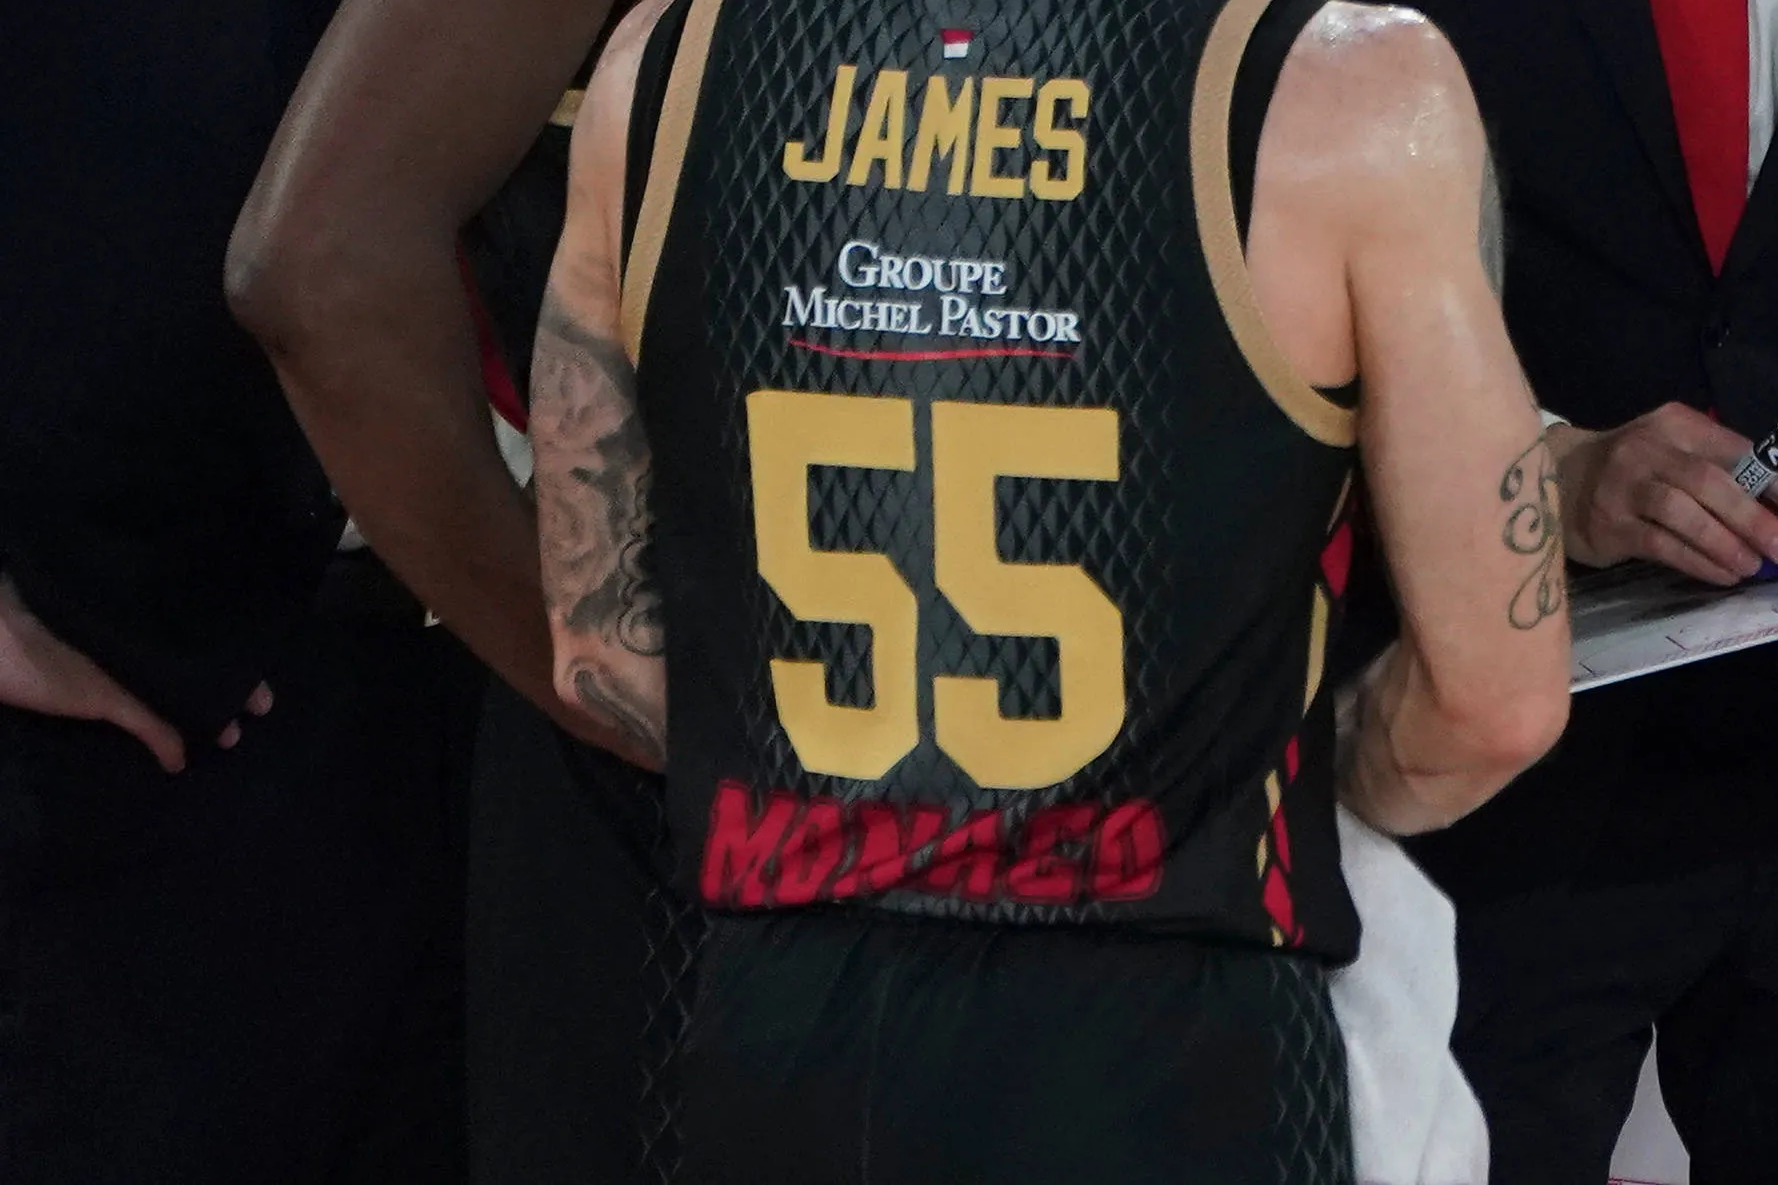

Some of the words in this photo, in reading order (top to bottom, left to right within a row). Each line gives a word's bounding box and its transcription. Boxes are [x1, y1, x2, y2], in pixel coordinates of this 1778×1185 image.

[782, 64, 1090, 201] JAMES
[745, 390, 1124, 790] 55
[700, 779, 1166, 906] MONACO
